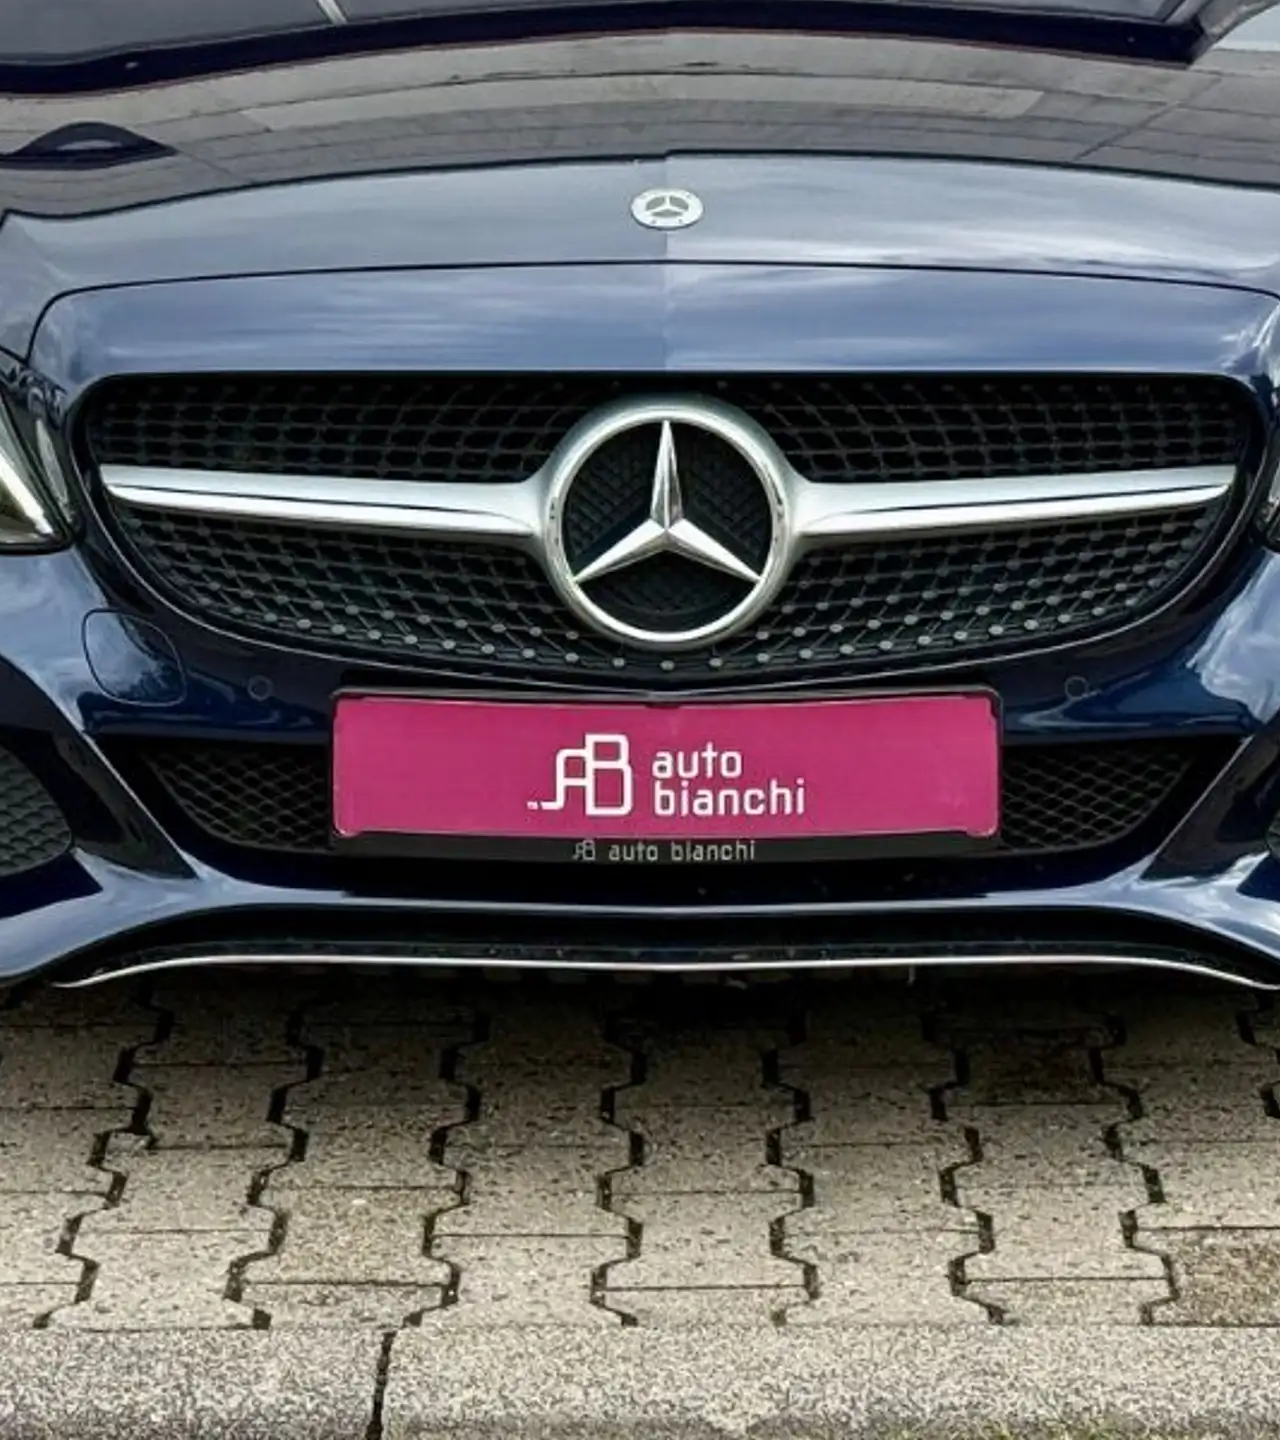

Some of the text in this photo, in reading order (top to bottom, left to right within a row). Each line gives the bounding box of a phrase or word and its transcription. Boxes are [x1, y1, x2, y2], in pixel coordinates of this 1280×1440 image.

[652, 741, 742, 778] auto
[654, 778, 805, 816] bianchi
[609, 841, 658, 861] auto
[671, 839, 756, 861] bianchi
